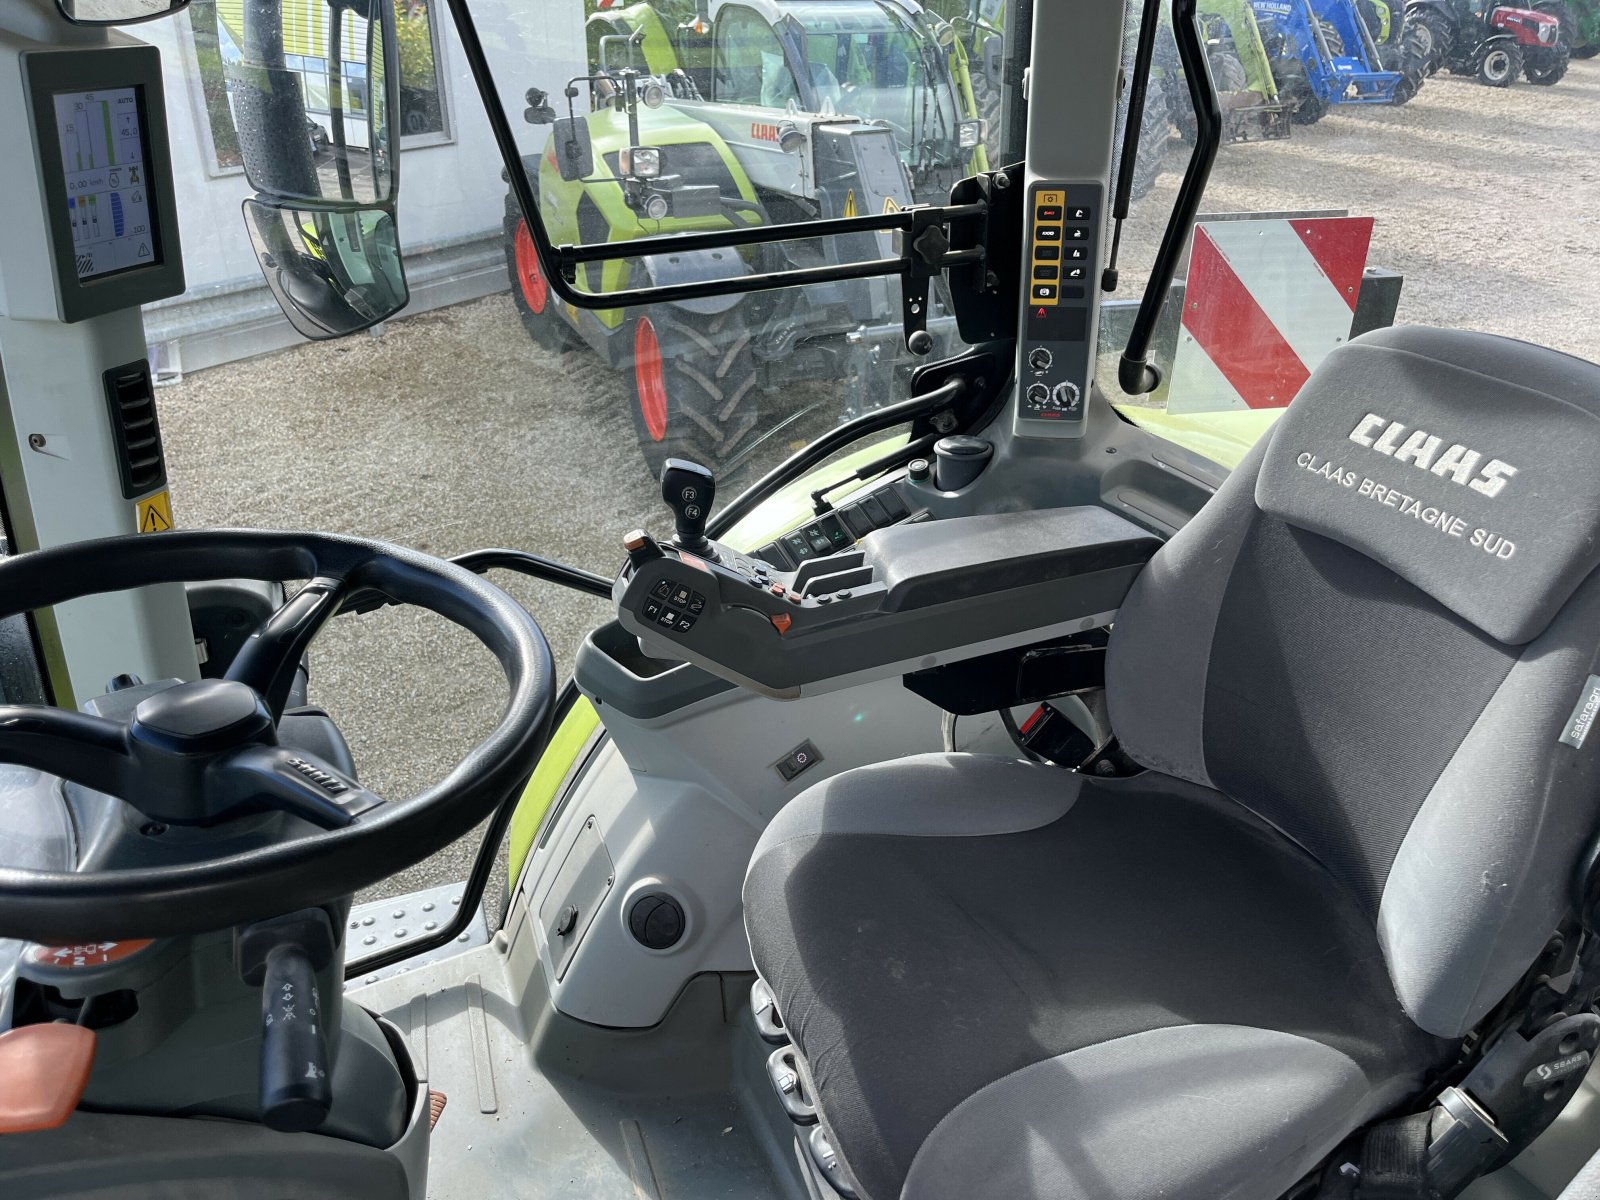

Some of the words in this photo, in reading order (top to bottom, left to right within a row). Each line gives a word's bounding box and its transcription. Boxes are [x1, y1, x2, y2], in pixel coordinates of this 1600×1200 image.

[751, 122, 777, 141] CLAA
[1347, 412, 1518, 498] CLAAS
[685, 490, 695, 499] F3
[1296, 451, 1357, 488] CLAAS
[1359, 477, 1468, 538] BRETAGNE
[1470, 528, 1517, 561] SUD
[688, 508, 697, 517] F4
[673, 596, 687, 604] STOP
[647, 605, 658, 614] F1
[660, 617, 674, 625] STOP
[679, 620, 690, 629] F2
[1554, 1055, 1581, 1069] SEARS
